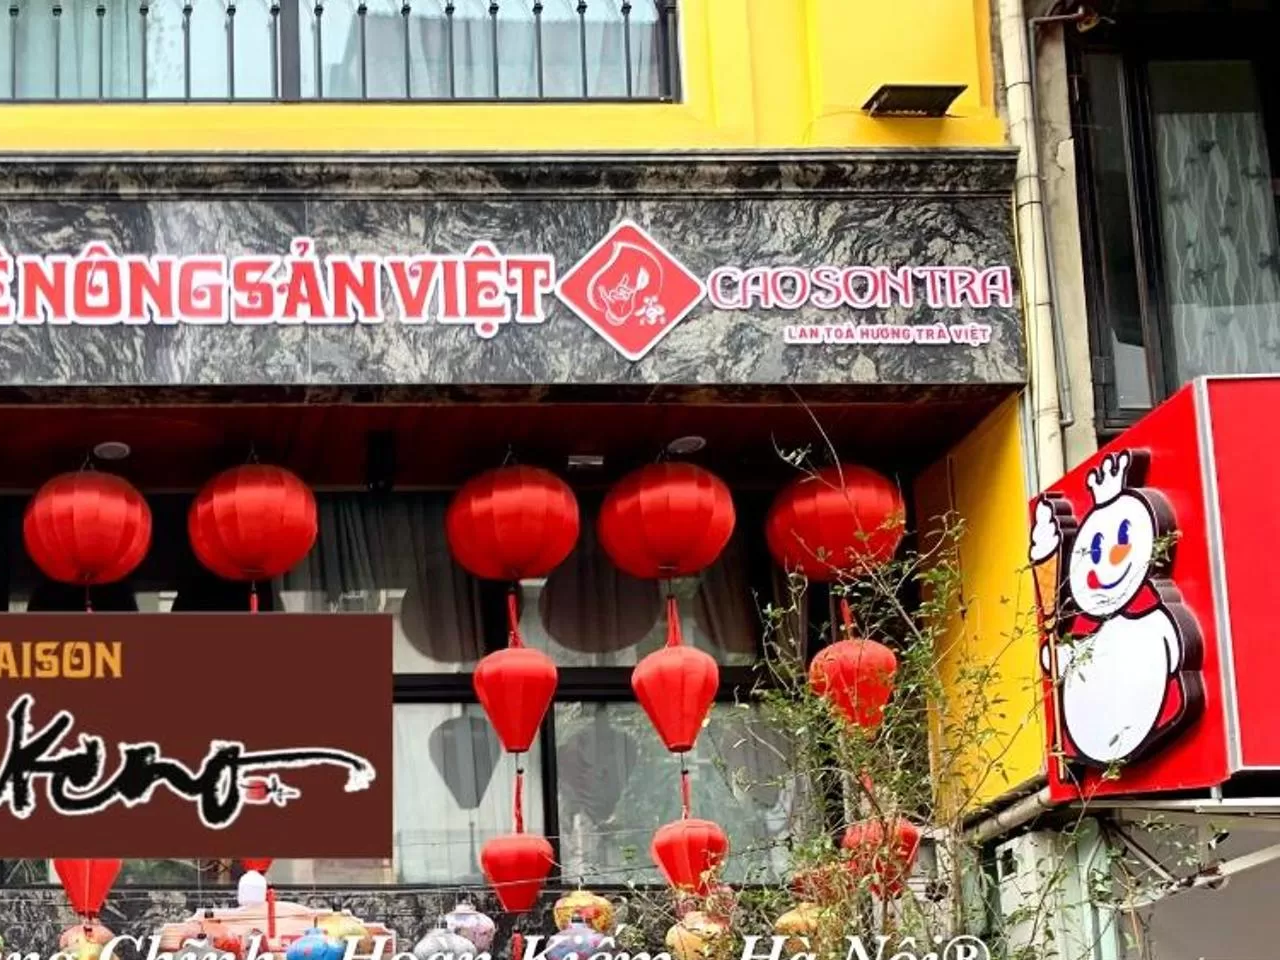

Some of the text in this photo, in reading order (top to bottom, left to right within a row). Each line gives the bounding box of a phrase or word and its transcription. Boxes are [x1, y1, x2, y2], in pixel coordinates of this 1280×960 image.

[21, 243, 223, 319] NÔNG
[232, 240, 381, 319] SẢN
[387, 243, 551, 336] VIỆT
